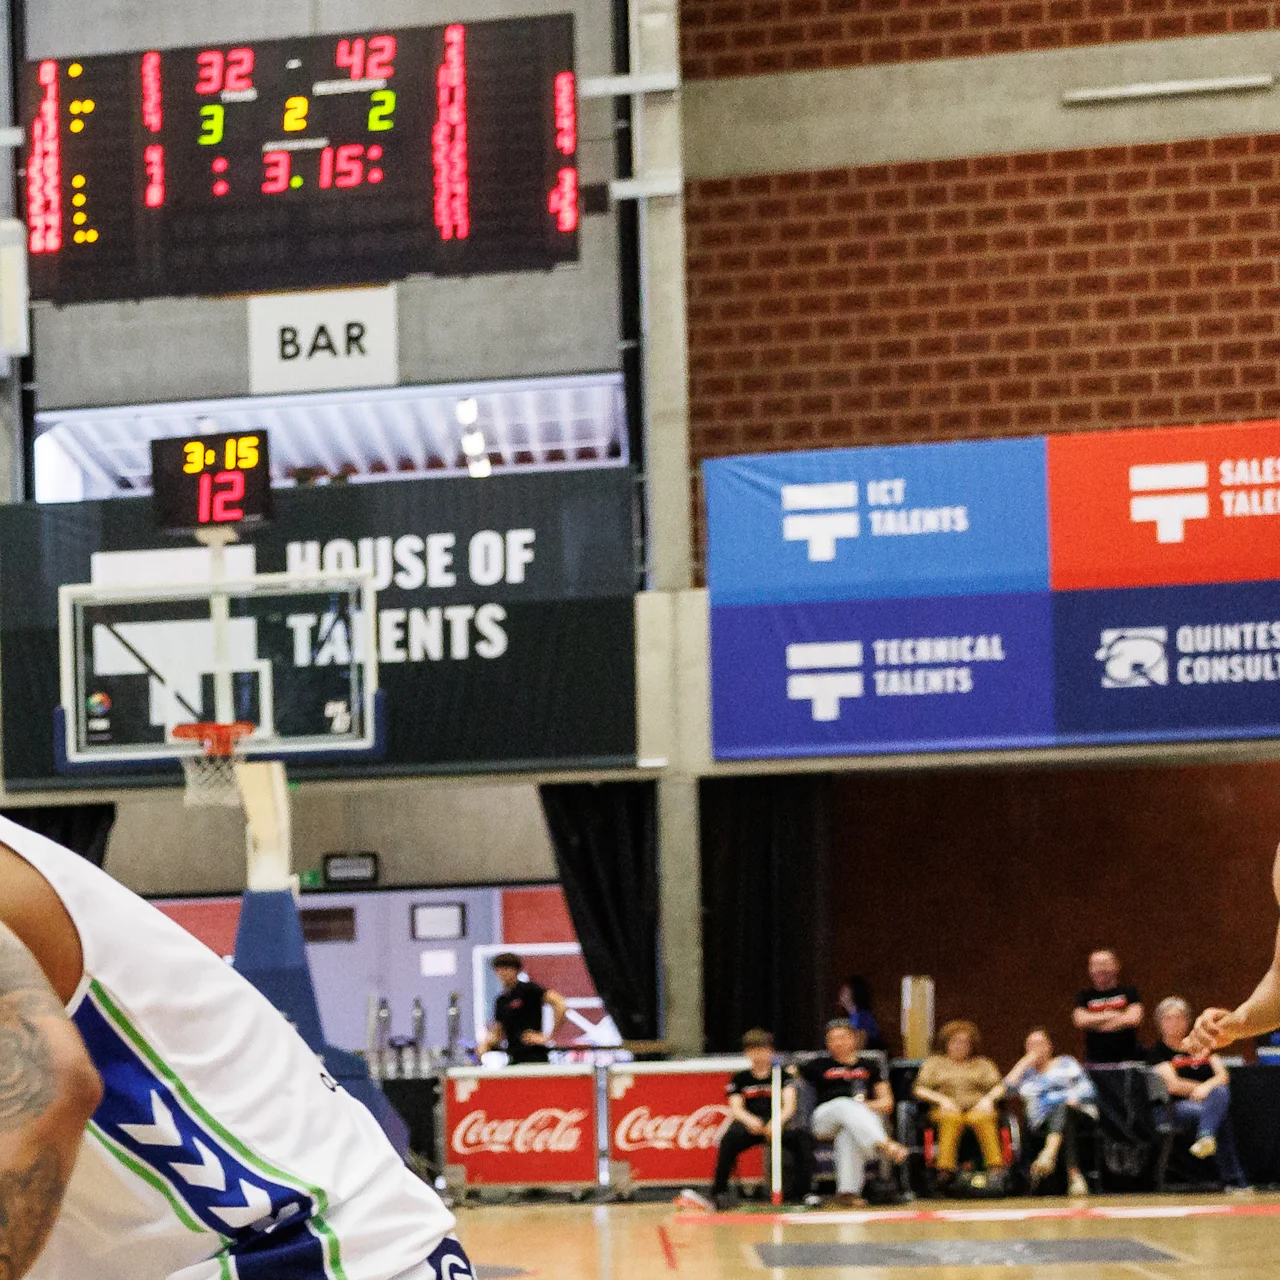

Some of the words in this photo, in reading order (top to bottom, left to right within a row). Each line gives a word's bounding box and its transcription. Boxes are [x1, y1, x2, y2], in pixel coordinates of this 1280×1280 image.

[195, 48, 256, 95] 32
[335, 35, 397, 80] 42
[197, 103, 225, 145] 3
[283, 95, 309, 132] 2
[367, 88, 397, 132] 2
[278, 322, 367, 361] BAR
[1219, 456, 1280, 487] SALE
[198, 470, 245, 523] 12
[866, 478, 906, 506] ICT
[1219, 487, 1280, 518] TALE
[868, 506, 969, 537] TALENTS
[285, 533, 457, 592] HOUSE
[467, 527, 538, 586] OF
[285, 603, 509, 668] TALENTS
[872, 634, 1006, 667] TECHNICAL
[872, 667, 974, 697] TALENTS
